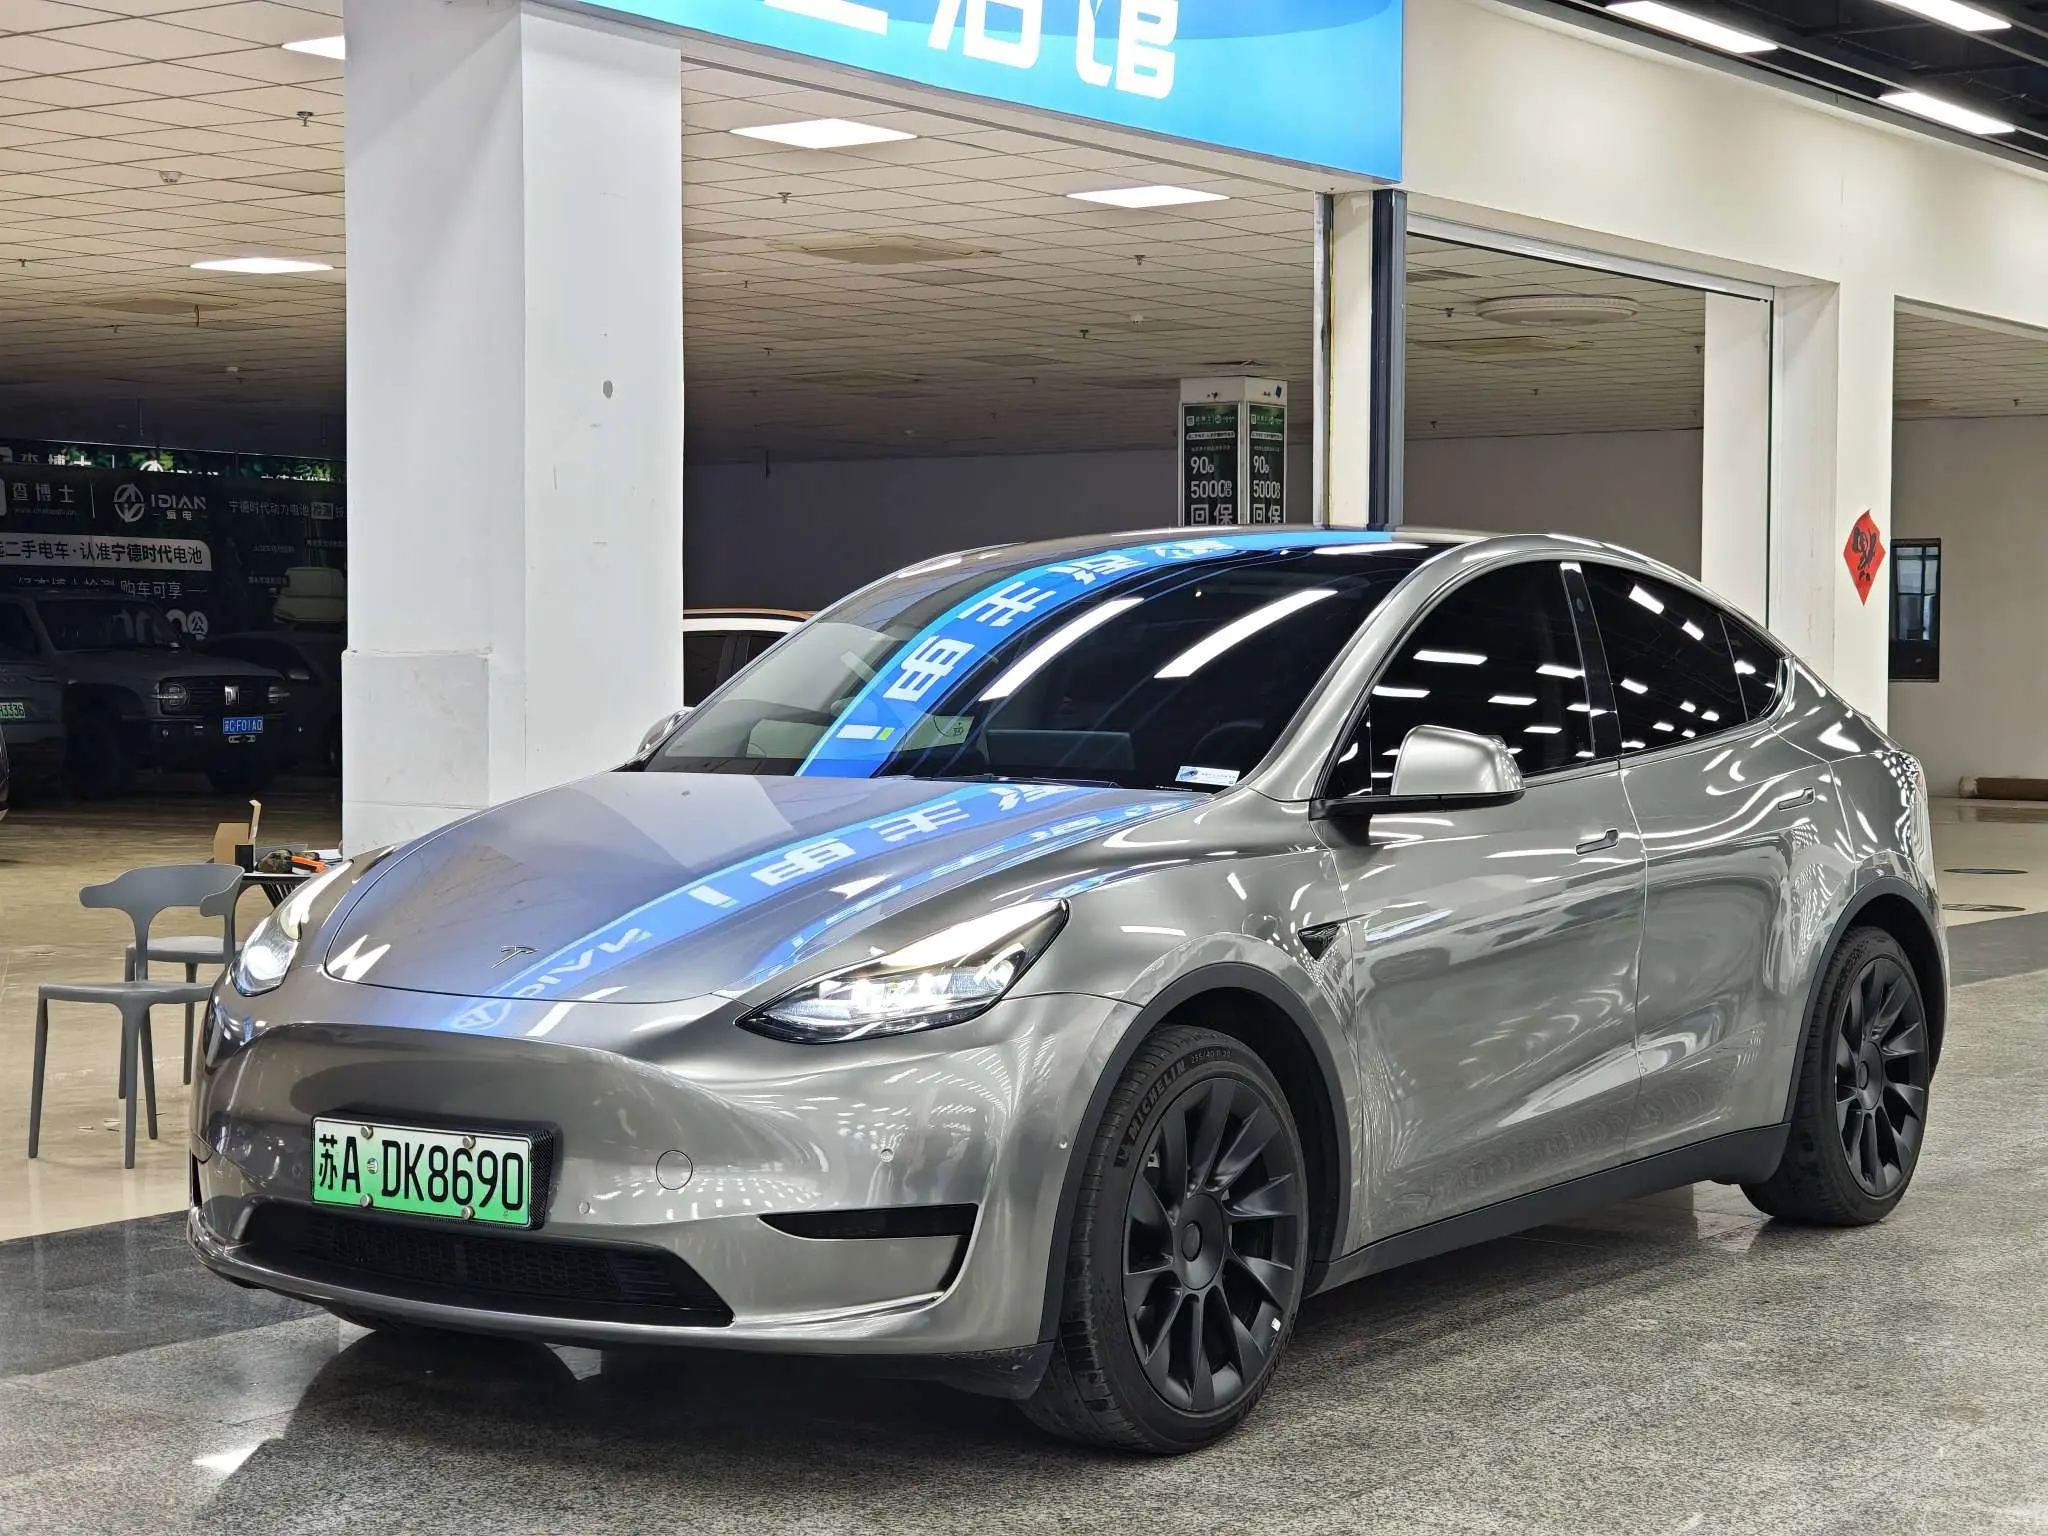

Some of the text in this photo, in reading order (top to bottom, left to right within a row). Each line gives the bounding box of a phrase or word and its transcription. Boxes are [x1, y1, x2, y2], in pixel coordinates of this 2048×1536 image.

[11, 482, 76, 504] 查博士
[150, 493, 207, 510] IDIAN
[120, 579, 183, 600] 购车可享
[1127, 1058, 1187, 1145] MICHELIN
[380, 1139, 524, 1212] DK8690
